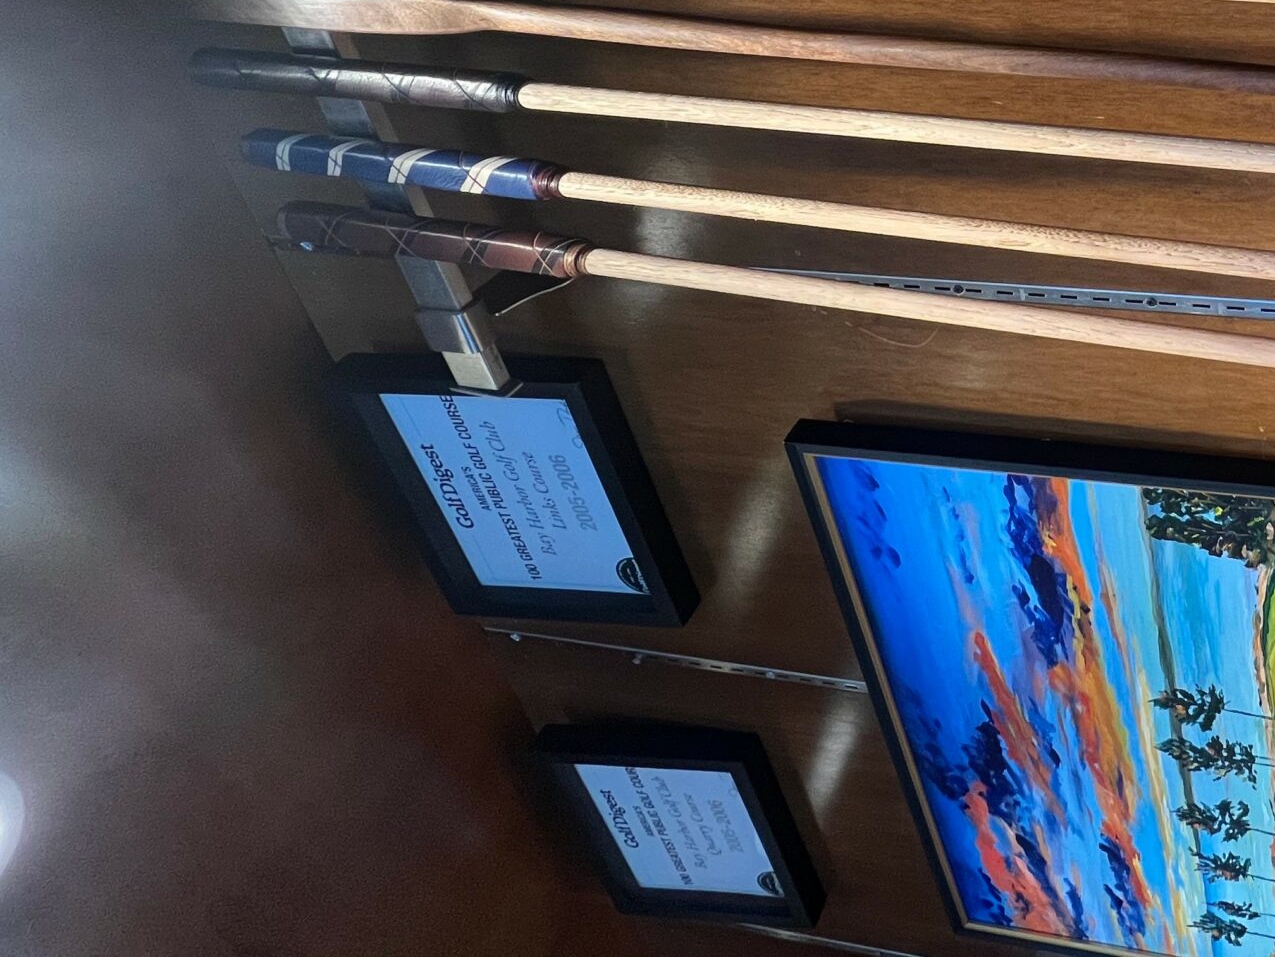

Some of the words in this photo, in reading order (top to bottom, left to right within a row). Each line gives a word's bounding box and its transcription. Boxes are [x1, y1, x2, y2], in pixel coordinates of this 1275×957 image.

[480, 421, 506, 452] Club
[464, 443, 488, 470] GOLF
[497, 454, 521, 482] Golf
[521, 452, 549, 494] Course
[461, 466, 492, 511] AMERICA'S
[478, 473, 509, 509] PUBLIC
[549, 454, 598, 531] 2005-2006
[514, 486, 544, 529] Harbor
[542, 498, 568, 530] Links
[500, 512, 534, 561] GREATEST
[537, 533, 558, 555] Bay
[524, 564, 543, 580] 100
[636, 790, 656, 808] GOLF
[663, 799, 682, 817] Golf
[682, 792, 702, 822] Course
[647, 810, 671, 836] PUBLIC
[675, 820, 698, 850] Harbor
[661, 838, 687, 872] GREATEST
